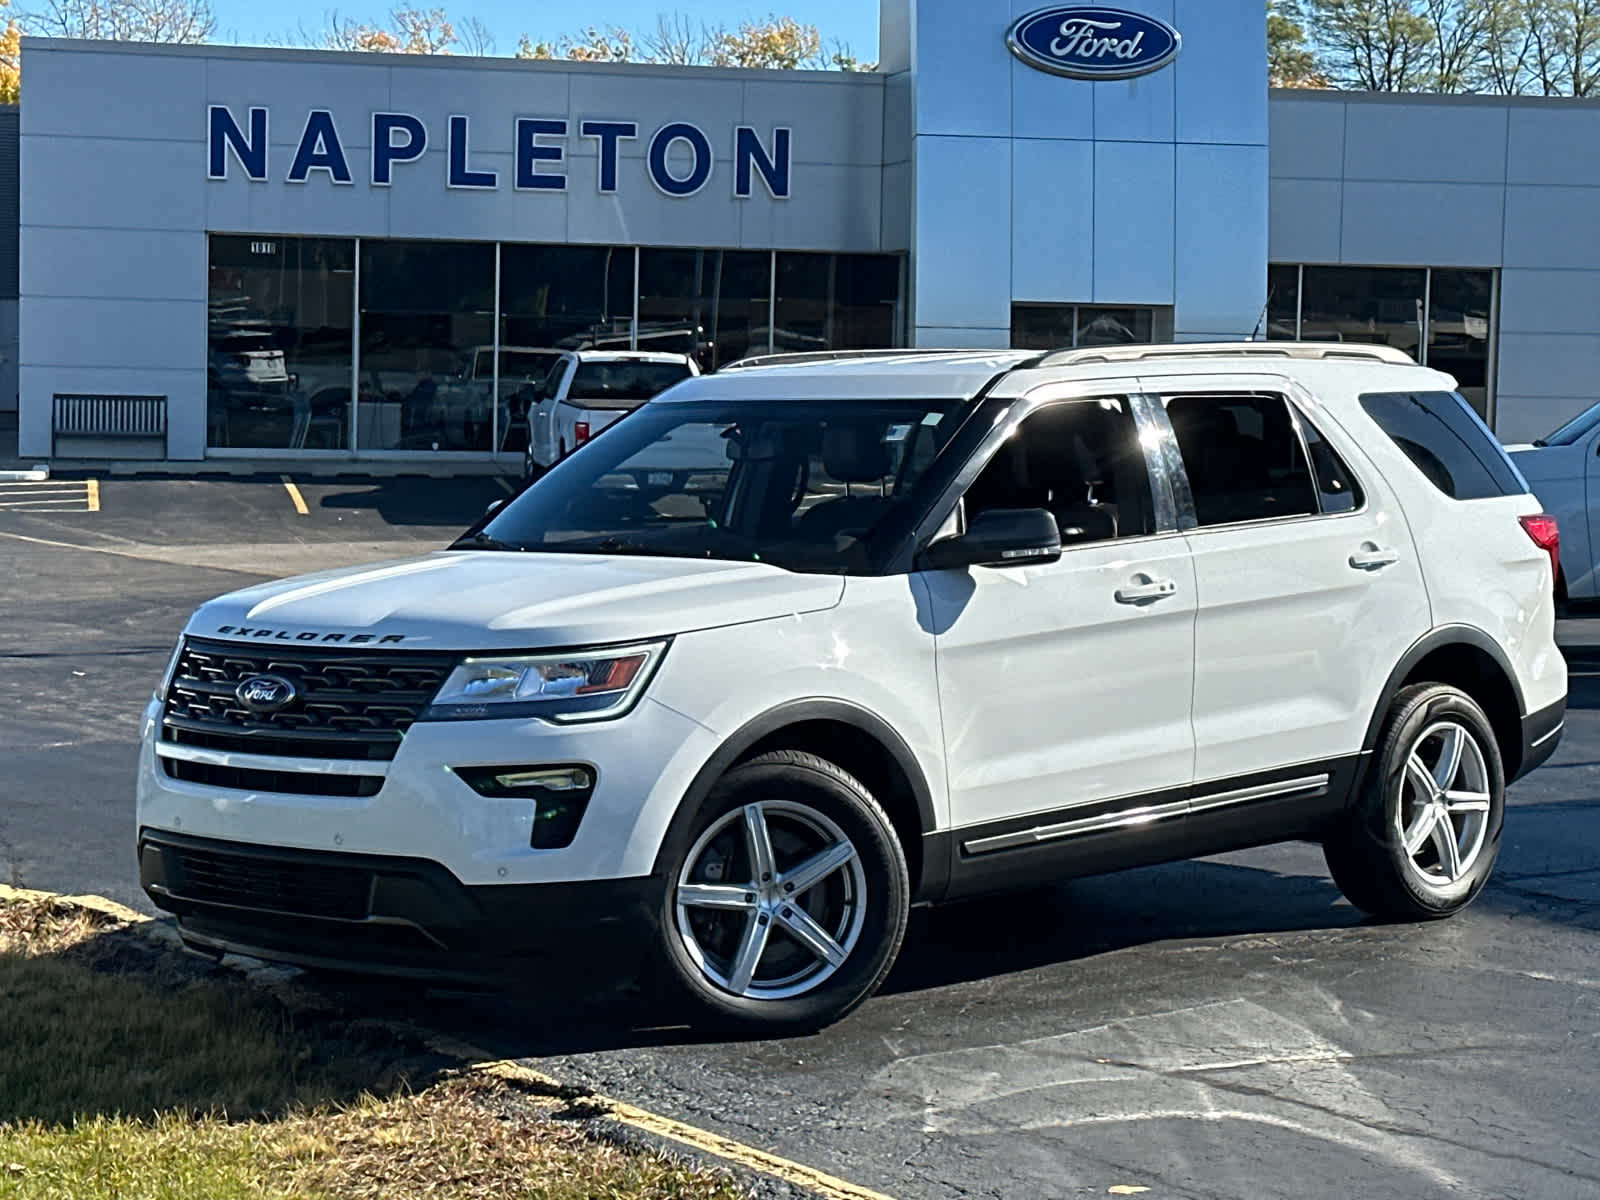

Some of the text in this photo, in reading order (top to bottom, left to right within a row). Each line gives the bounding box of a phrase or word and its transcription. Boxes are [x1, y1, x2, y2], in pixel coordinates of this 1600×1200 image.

[1050, 18, 1145, 59] Ford
[207, 104, 792, 199] NAPLETON
[216, 625, 406, 645] EXPLORER
[244, 680, 278, 701] Ford
